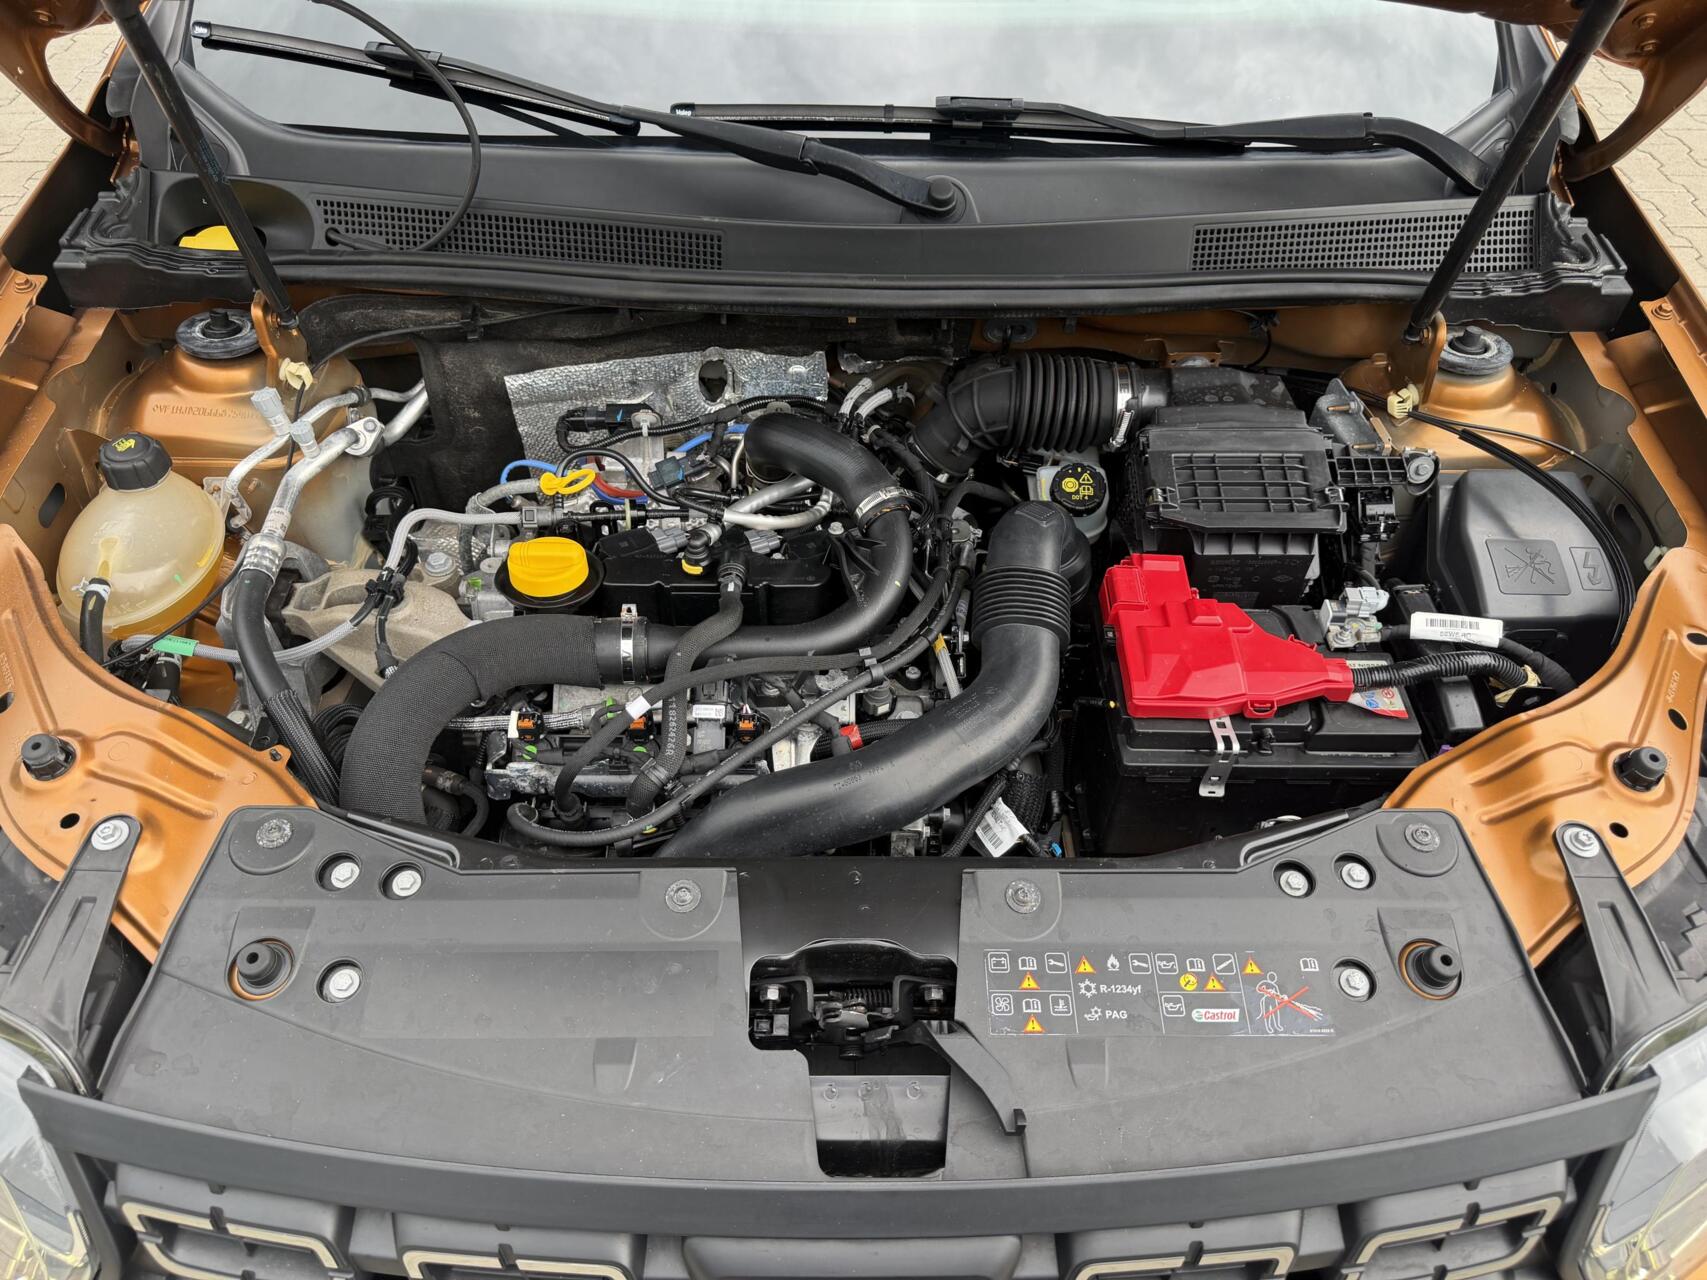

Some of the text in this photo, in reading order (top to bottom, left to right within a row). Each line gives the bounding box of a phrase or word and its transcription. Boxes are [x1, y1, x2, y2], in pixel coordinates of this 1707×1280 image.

[1100, 984, 1142, 996] R-1234yf
[1105, 1010, 1128, 1019] PAG
[1203, 1010, 1237, 1021] Castrol
